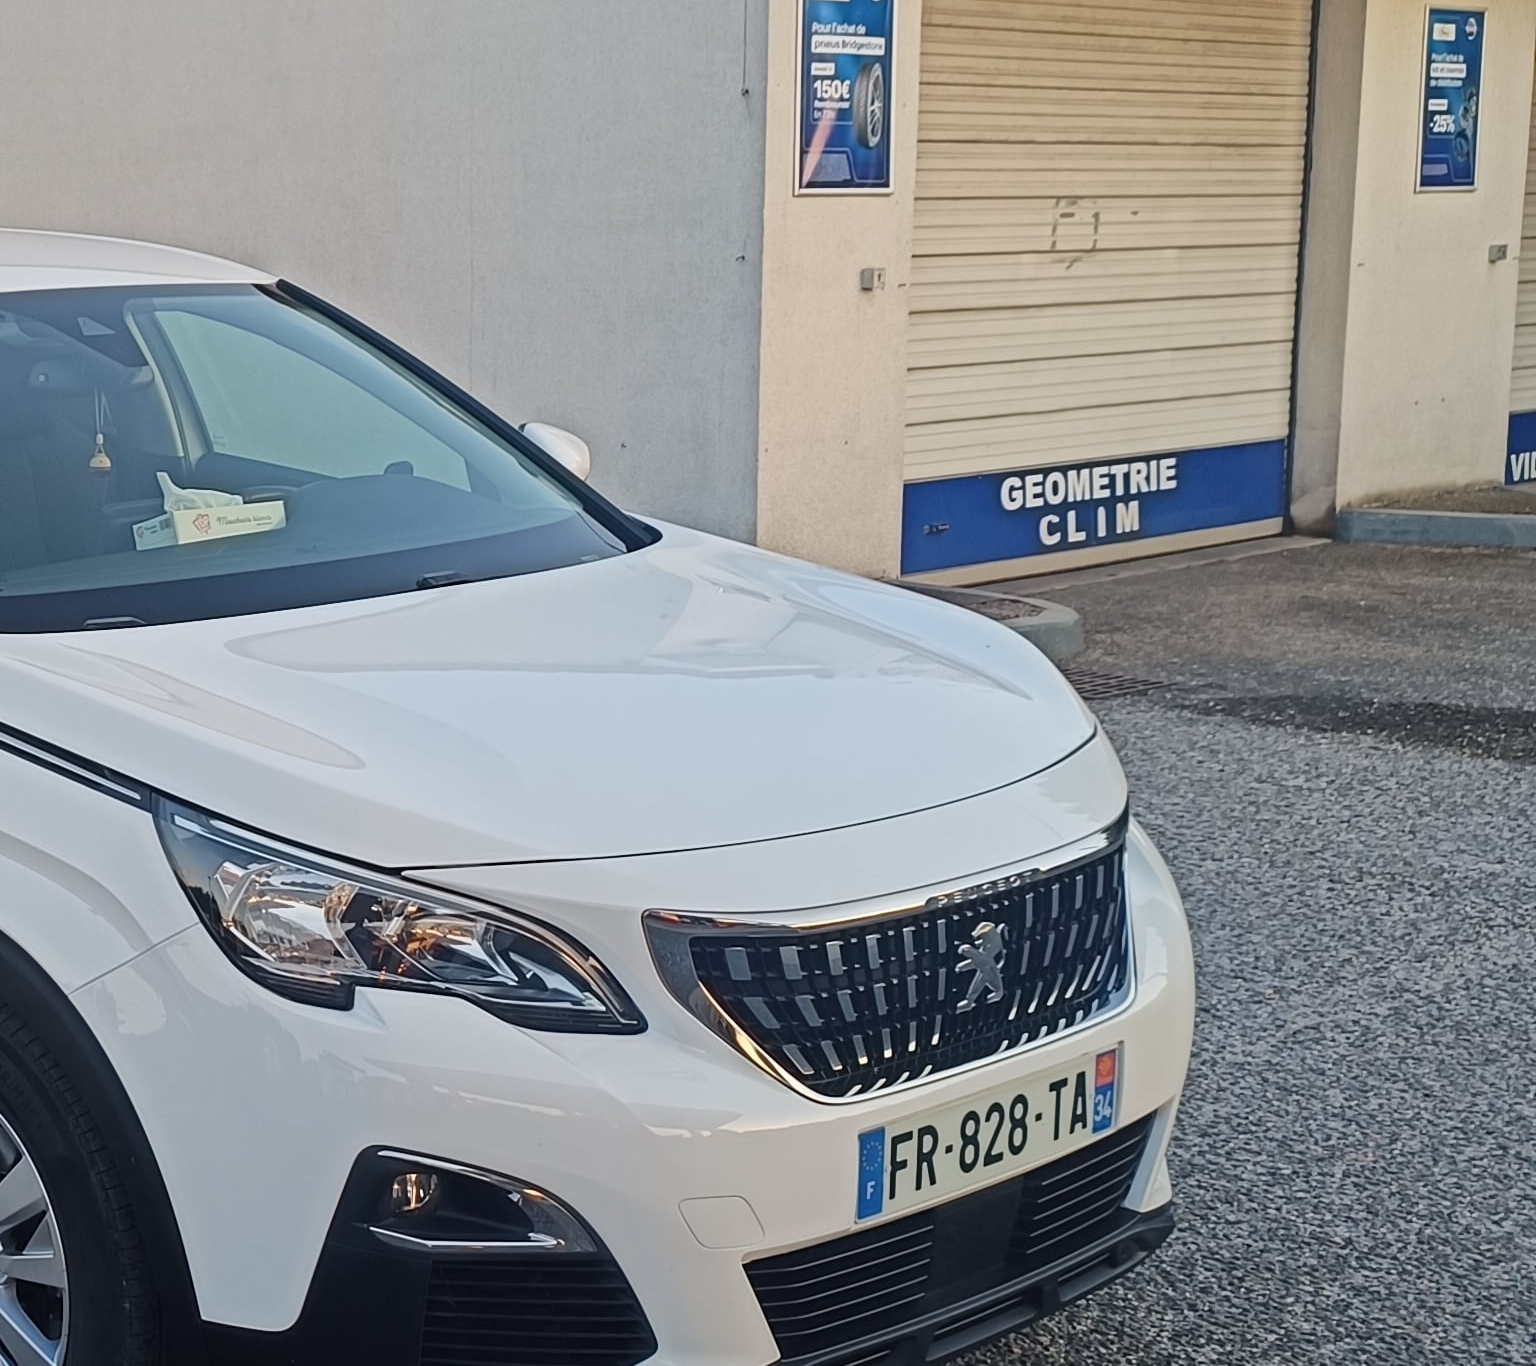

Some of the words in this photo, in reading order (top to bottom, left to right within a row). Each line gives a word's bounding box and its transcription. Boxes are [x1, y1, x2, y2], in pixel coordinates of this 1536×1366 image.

[814, 39, 840, 50] pneus
[842, 39, 882, 52] Bridgestone
[813, 79, 851, 99] 150€
[1000, 457, 1178, 511] GEOMETRIE
[937, 871, 1033, 908] PEUGEOT
[1094, 1091, 1113, 1123] 34
[889, 1071, 1088, 1200] FR-828-TA
[866, 1180, 875, 1201] F
